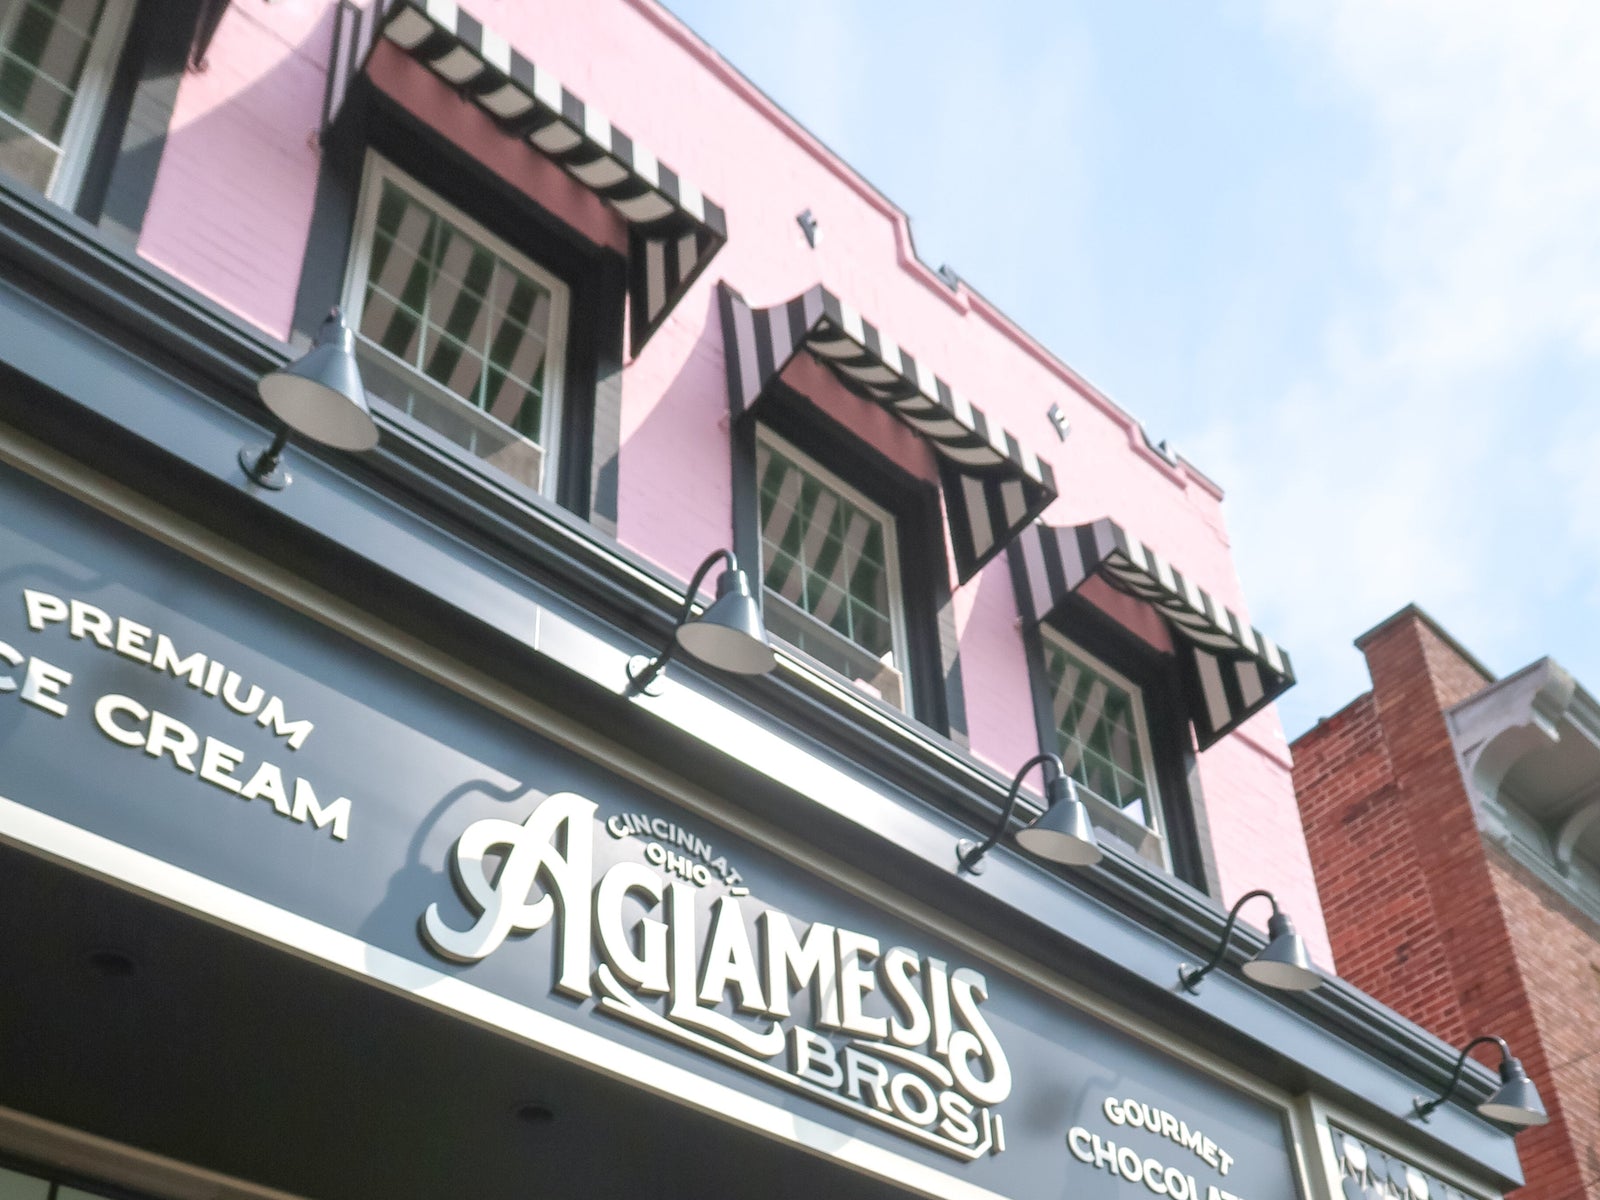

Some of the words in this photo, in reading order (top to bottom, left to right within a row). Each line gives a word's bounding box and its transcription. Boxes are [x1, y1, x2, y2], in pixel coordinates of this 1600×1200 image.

[23, 588, 316, 752] PREMIUM
[94, 693, 352, 841] CREAM
[607, 812, 750, 896] CINCINNATI
[646, 841, 713, 887] OHIO
[420, 791, 1013, 1107] AGLAMESIS
[792, 1025, 979, 1147] BROS
[1104, 1096, 1234, 1176] GOURMET
